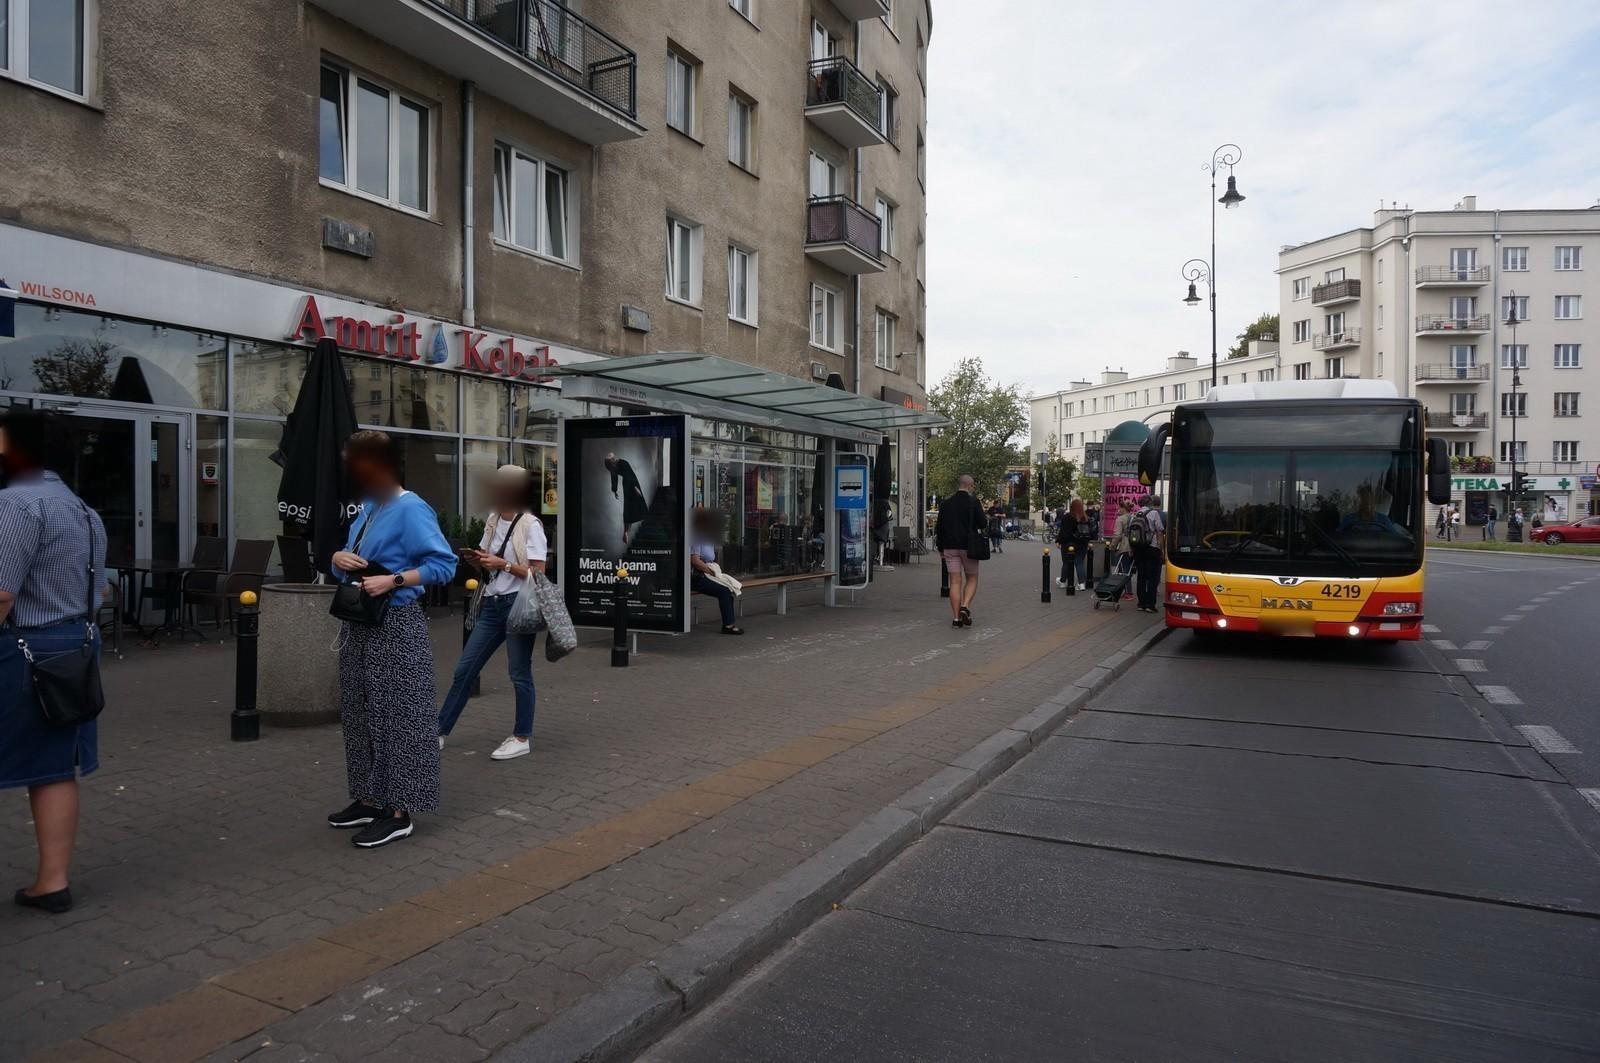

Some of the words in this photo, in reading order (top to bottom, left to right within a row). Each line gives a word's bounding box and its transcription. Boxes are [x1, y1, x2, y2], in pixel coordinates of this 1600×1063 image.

[21, 281, 97, 306] WILSONA
[288, 295, 422, 361] Amrit
[1450, 478, 1499, 490] TEKA
[278, 501, 312, 518] epsi
[579, 557, 613, 570] Matka
[615, 558, 657, 572] Joanna
[580, 572, 594, 583] od
[1321, 584, 1361, 599] 4219
[1261, 598, 1313, 610] MAN
